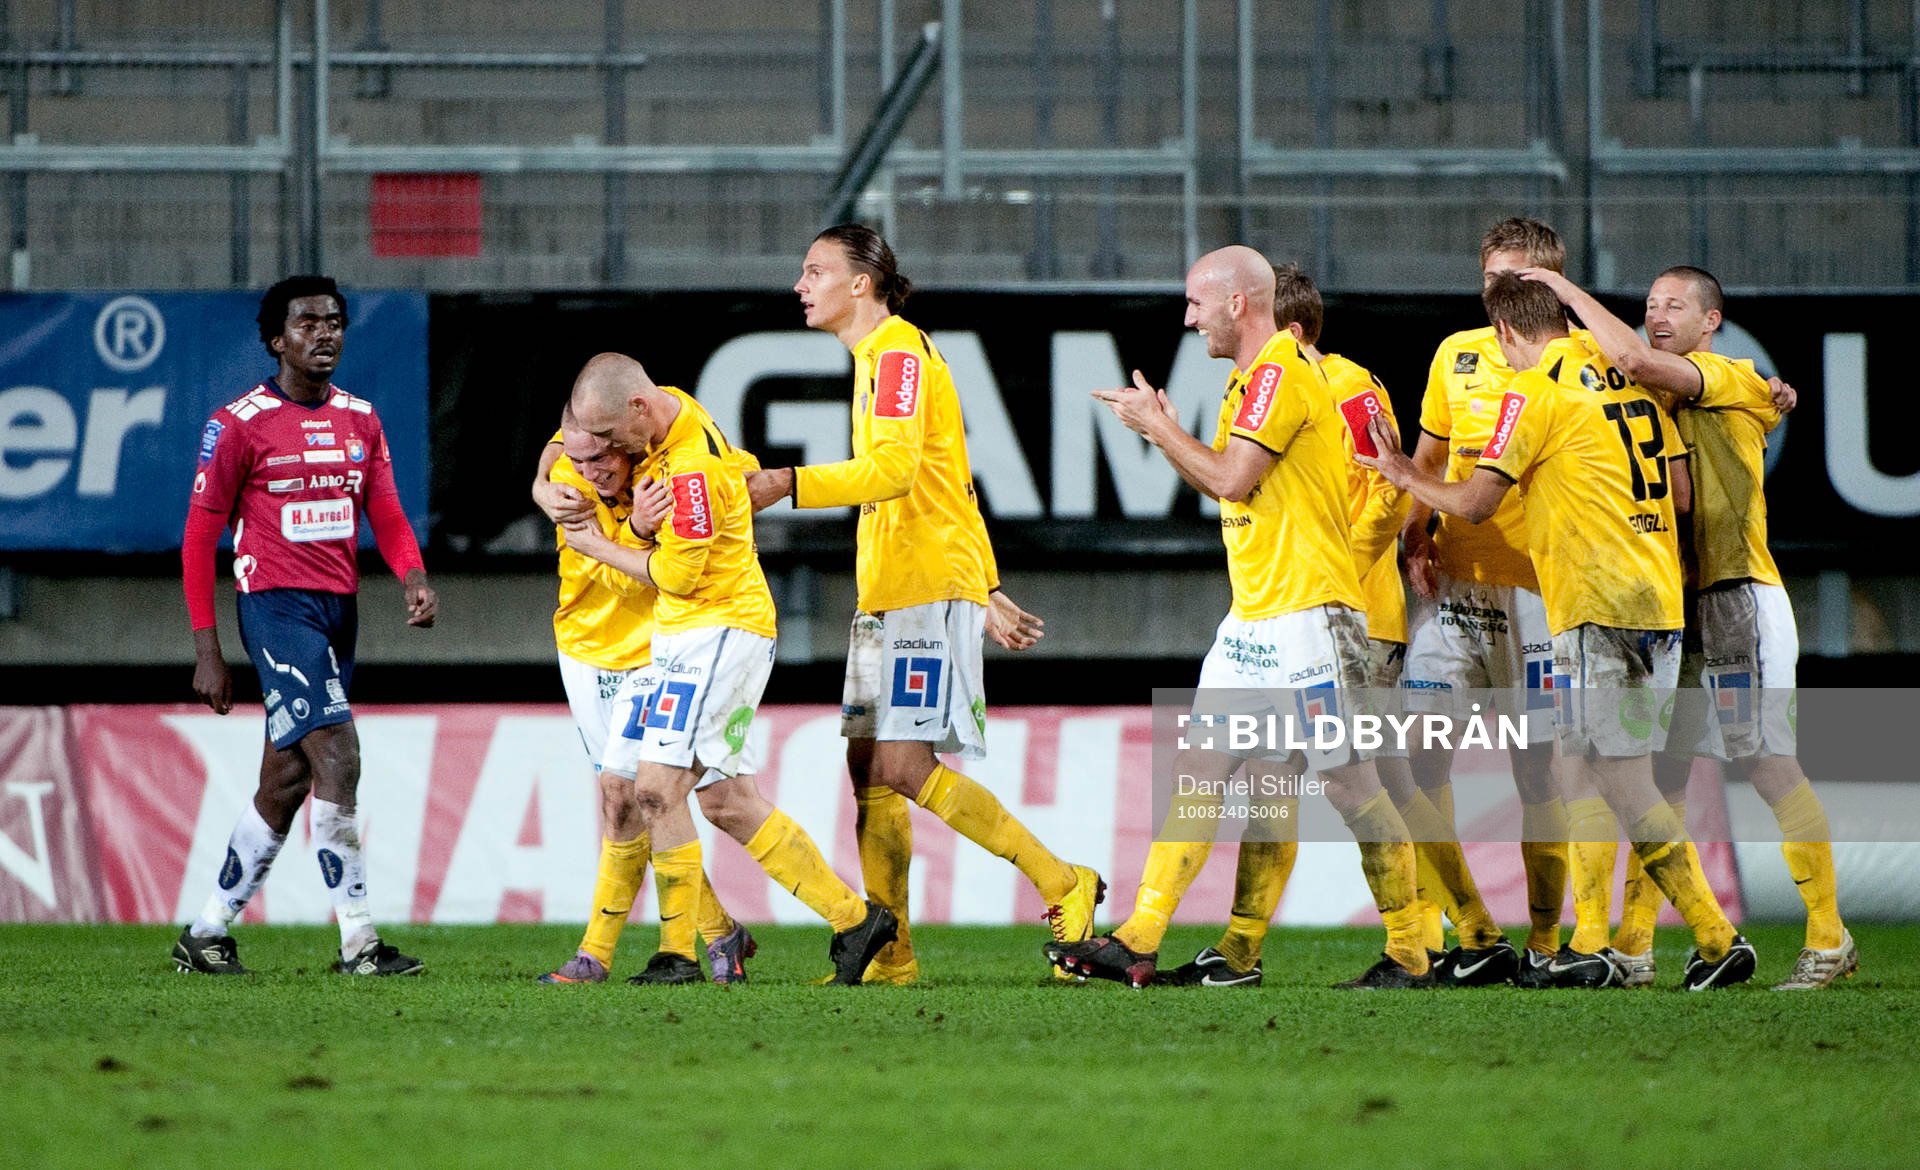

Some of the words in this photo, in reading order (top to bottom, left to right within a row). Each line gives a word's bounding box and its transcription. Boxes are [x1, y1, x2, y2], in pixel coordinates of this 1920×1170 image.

[895, 357, 916, 413] Adecco
[1247, 368, 1277, 427] Adecco
[697, 331, 1236, 518] GAM
[1493, 398, 1521, 455] Adecco
[1602, 398, 1668, 502] 13
[687, 477, 709, 535] Adecco
[893, 638, 943, 650] stadium
